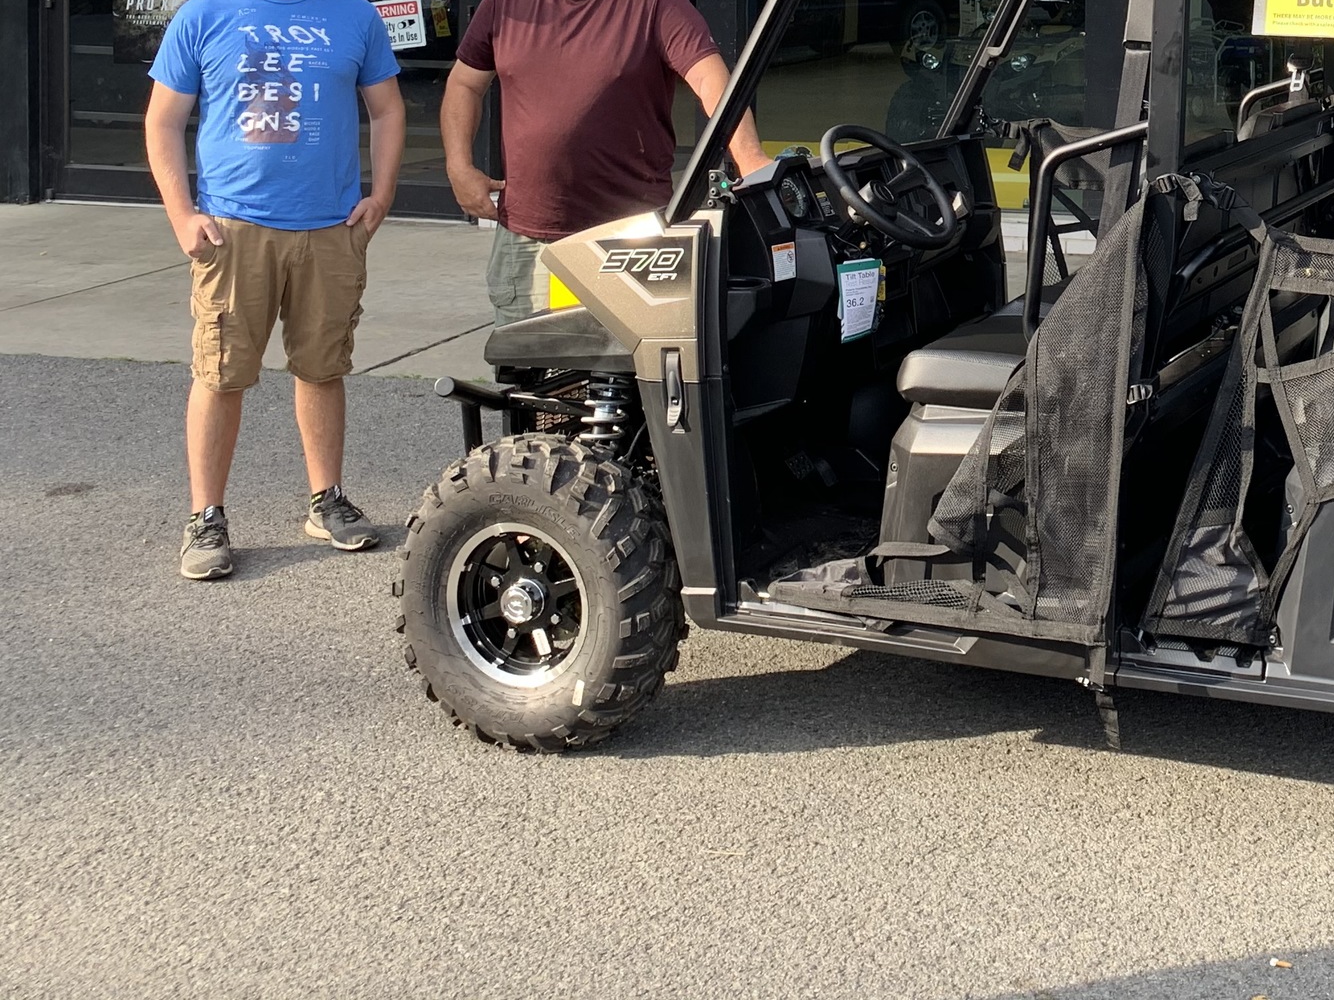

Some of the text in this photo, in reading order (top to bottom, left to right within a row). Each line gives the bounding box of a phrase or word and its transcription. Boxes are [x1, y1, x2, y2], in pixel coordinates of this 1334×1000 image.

[377, 3, 416, 18] ARNING
[238, 24, 331, 46] TROY
[406, 31, 418, 42] Use
[237, 52, 318, 73] LEE
[238, 82, 320, 102] DESI
[237, 111, 301, 132] GNS
[599, 248, 684, 273] 570
[647, 273, 678, 281] EFI
[857, 271, 875, 279] Table
[846, 296, 865, 308] 36.2
[488, 491, 582, 541] CARLISLE
